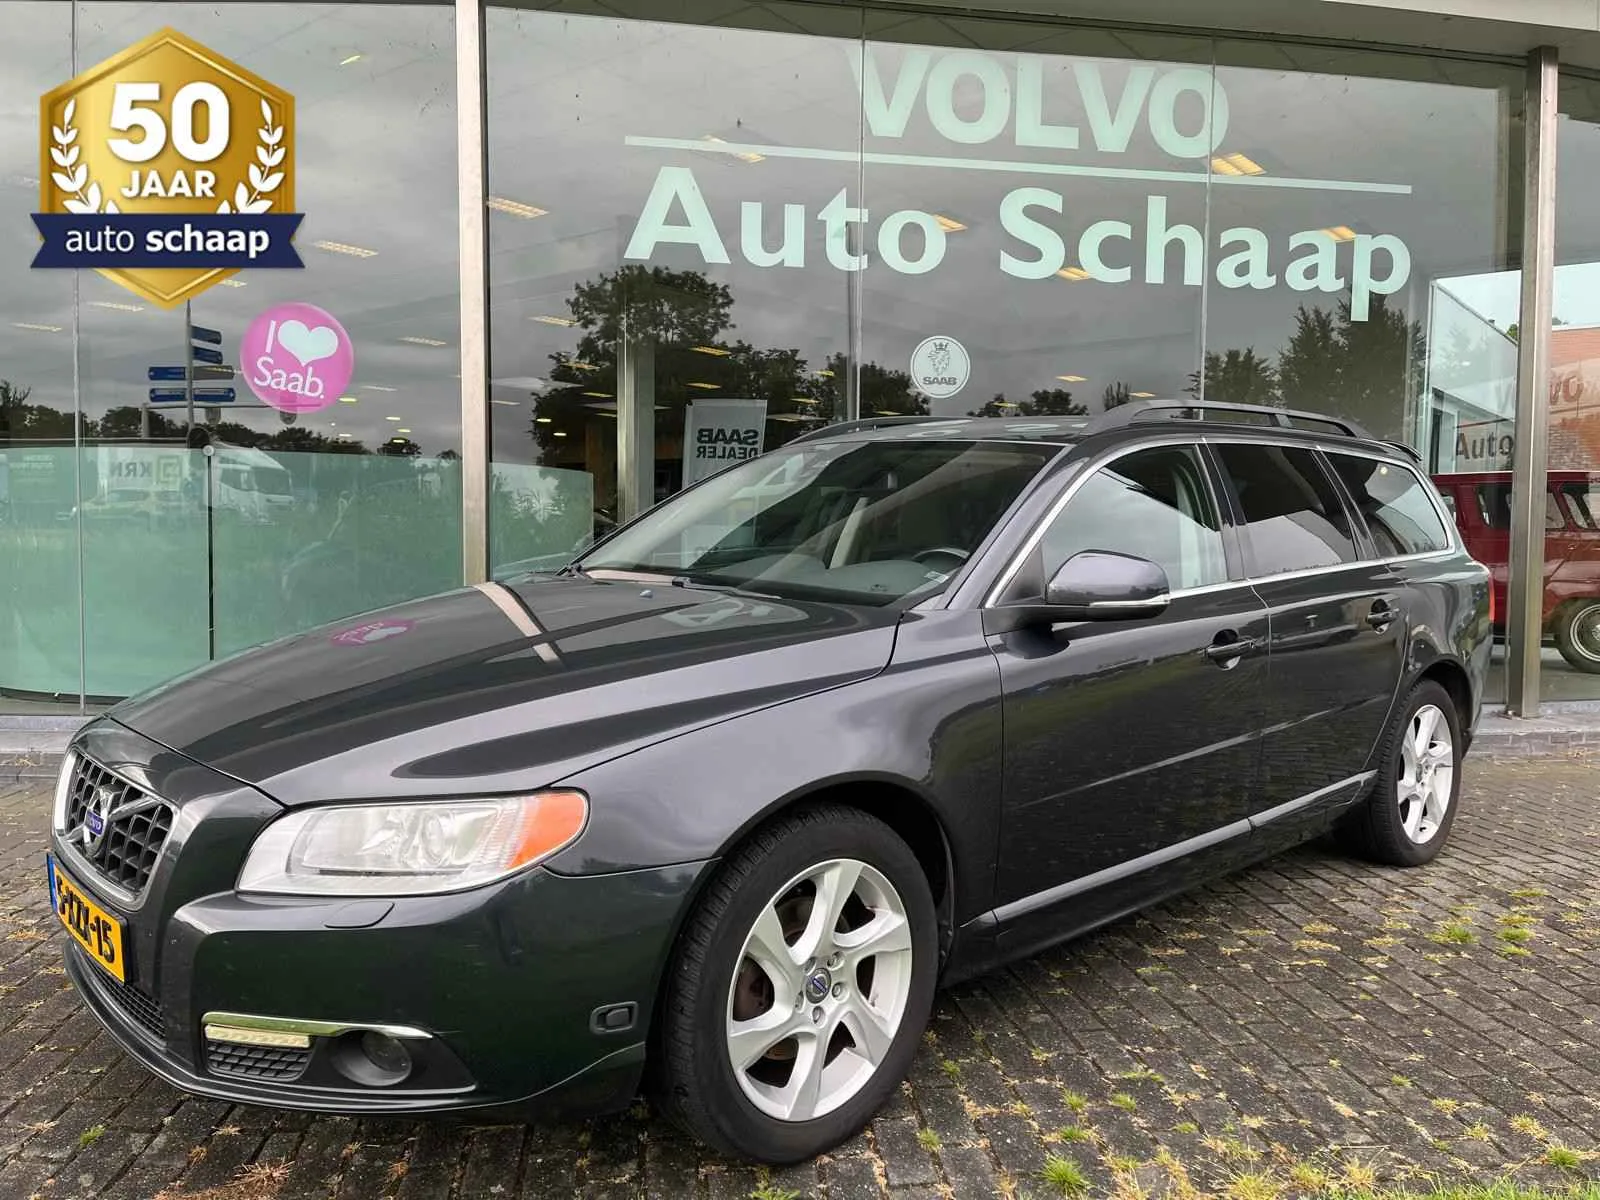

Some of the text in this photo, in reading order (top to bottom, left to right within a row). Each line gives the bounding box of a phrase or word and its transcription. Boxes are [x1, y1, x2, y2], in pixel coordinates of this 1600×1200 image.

[847, 48, 1229, 159] VOLVO
[623, 166, 1411, 322] Auto Schaap
[265, 320, 276, 353] I
[922, 376, 958, 386] SAAB
[1455, 431, 1514, 460] Auto
